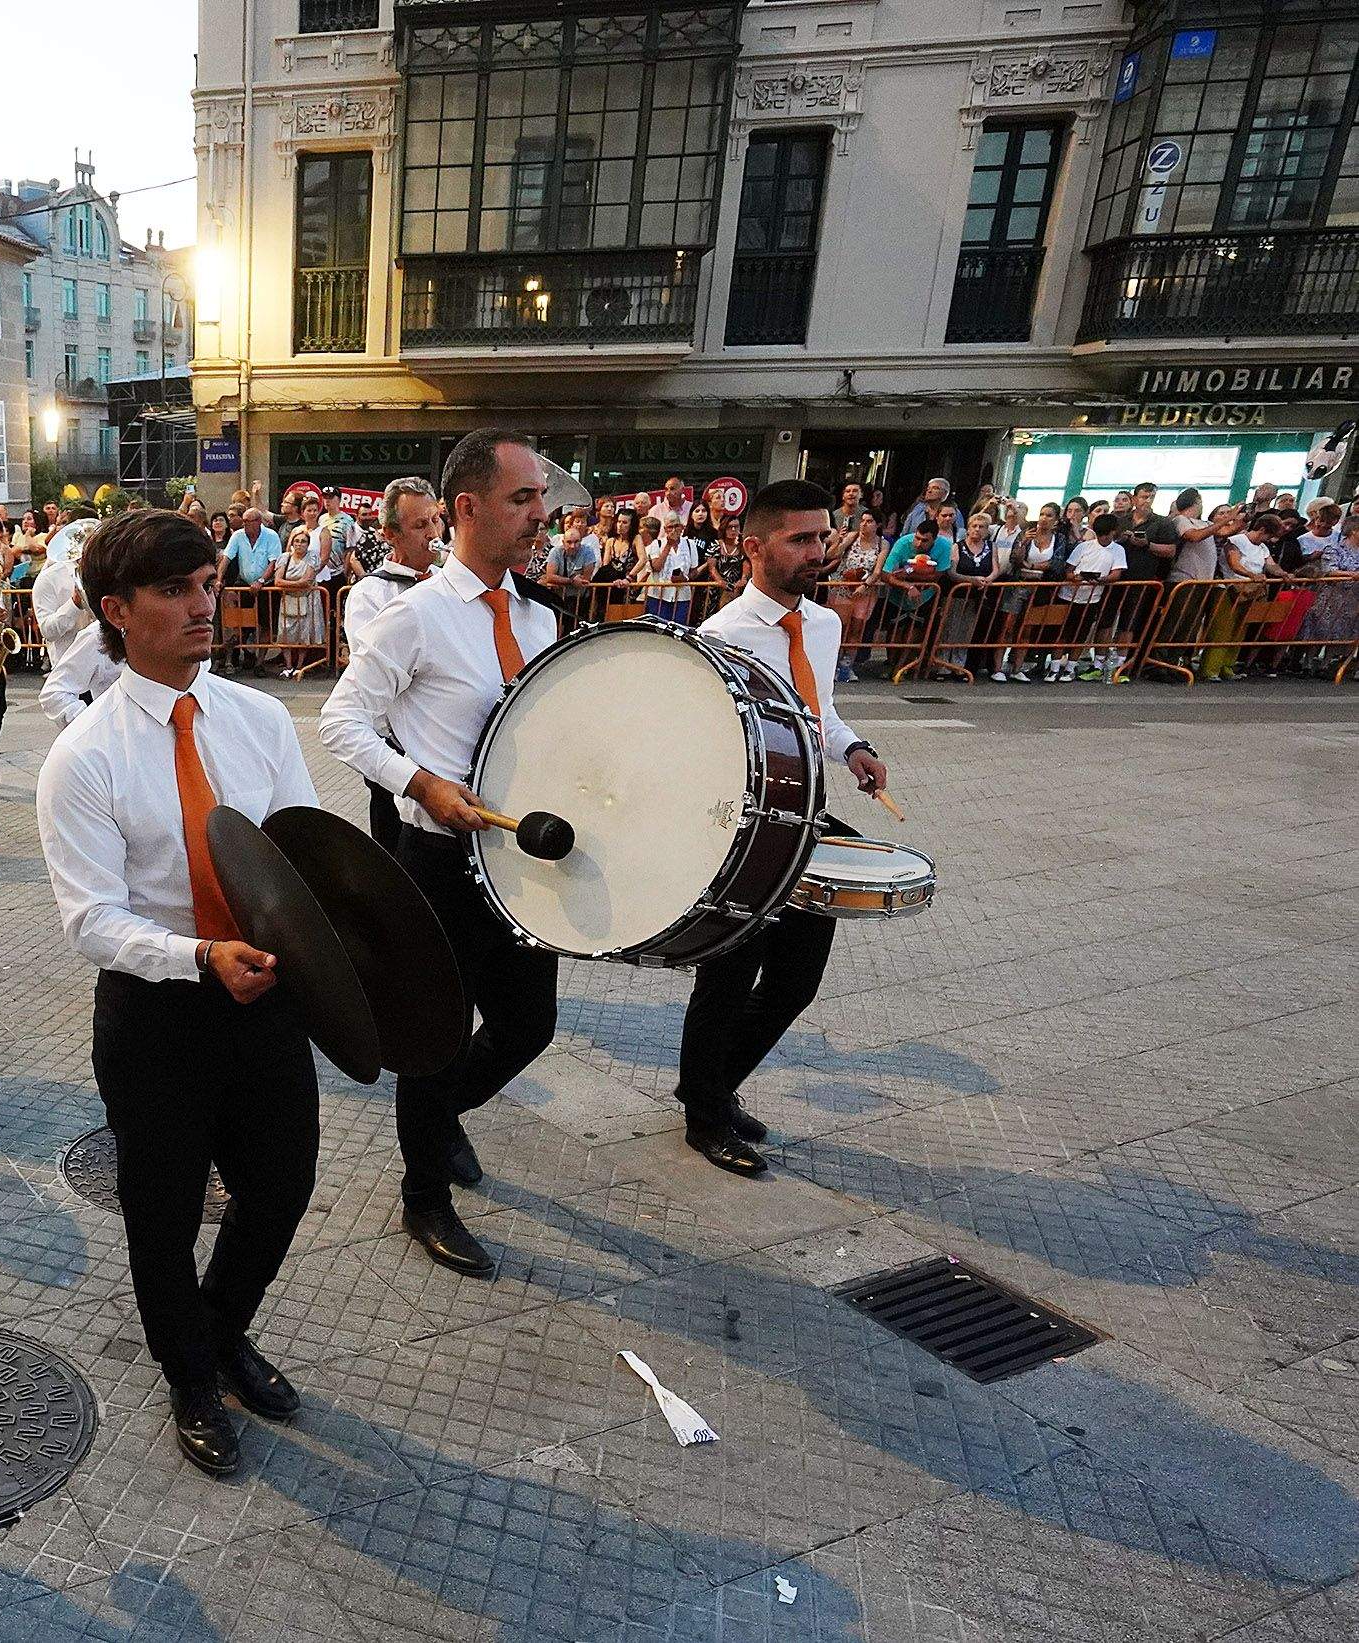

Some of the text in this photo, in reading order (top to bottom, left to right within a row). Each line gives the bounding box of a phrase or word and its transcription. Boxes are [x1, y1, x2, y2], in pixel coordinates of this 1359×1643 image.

[1139, 366, 1354, 393] INMOBILIAR
[1120, 403, 1267, 426] PEDROSA
[295, 444, 414, 463] ARESSO
[339, 492, 385, 511] REBA
